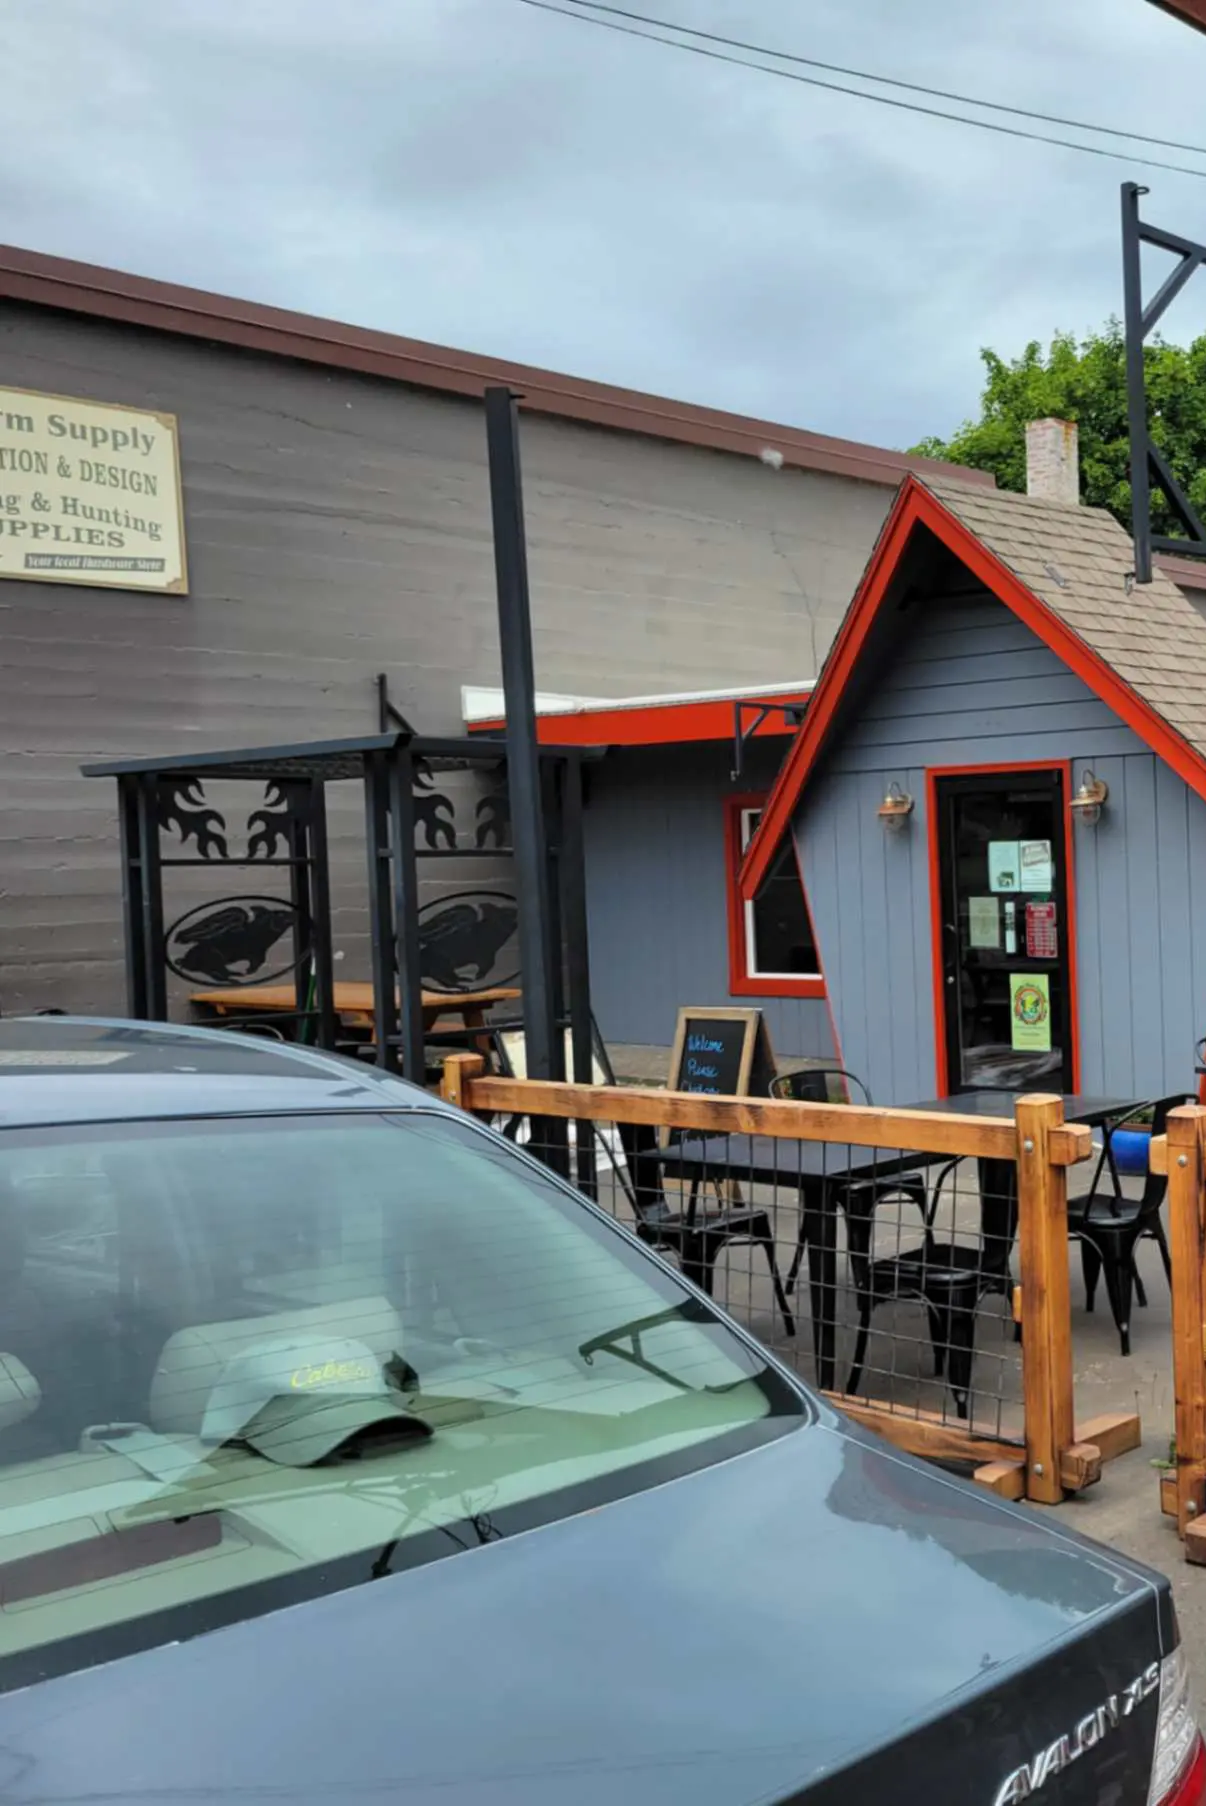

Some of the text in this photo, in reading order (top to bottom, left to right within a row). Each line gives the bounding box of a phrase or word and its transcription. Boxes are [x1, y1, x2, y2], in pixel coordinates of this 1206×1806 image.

[0, 411, 155, 455] m Supply
[57, 455, 71, 478] &
[79, 459, 157, 496] DESIGN
[31, 491, 51, 513] &
[60, 495, 162, 541] Hunting
[687, 1034, 724, 1053] Welcome
[994, 1694, 1118, 1806] AVALON
